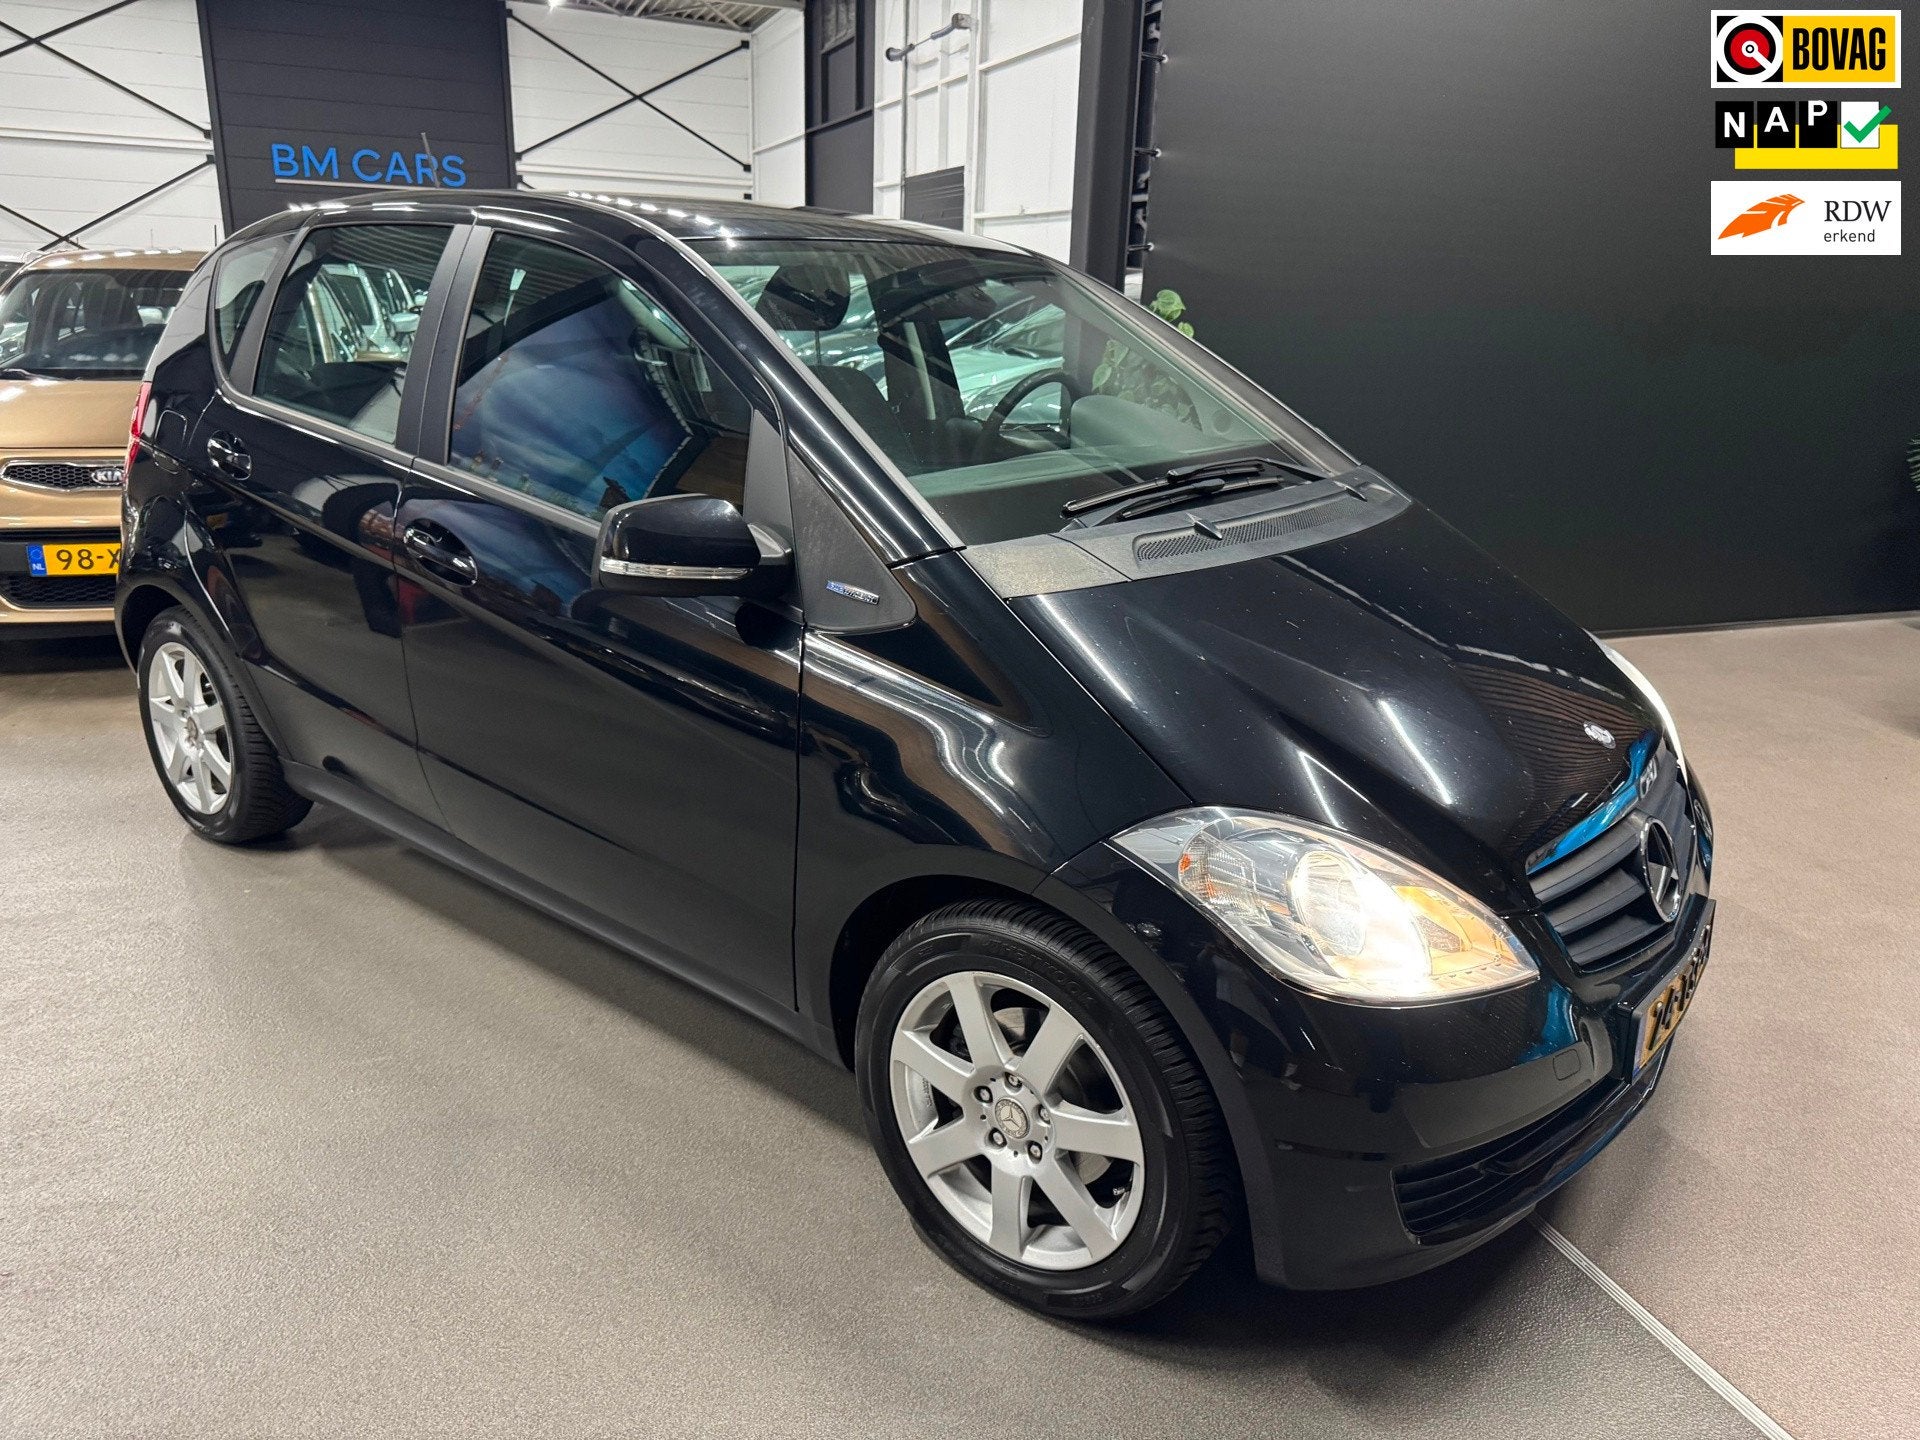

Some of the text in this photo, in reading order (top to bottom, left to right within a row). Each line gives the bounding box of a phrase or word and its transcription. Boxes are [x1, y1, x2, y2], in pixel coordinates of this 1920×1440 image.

[271, 143, 467, 188] BM CARS
[96, 470, 123, 482] KIA
